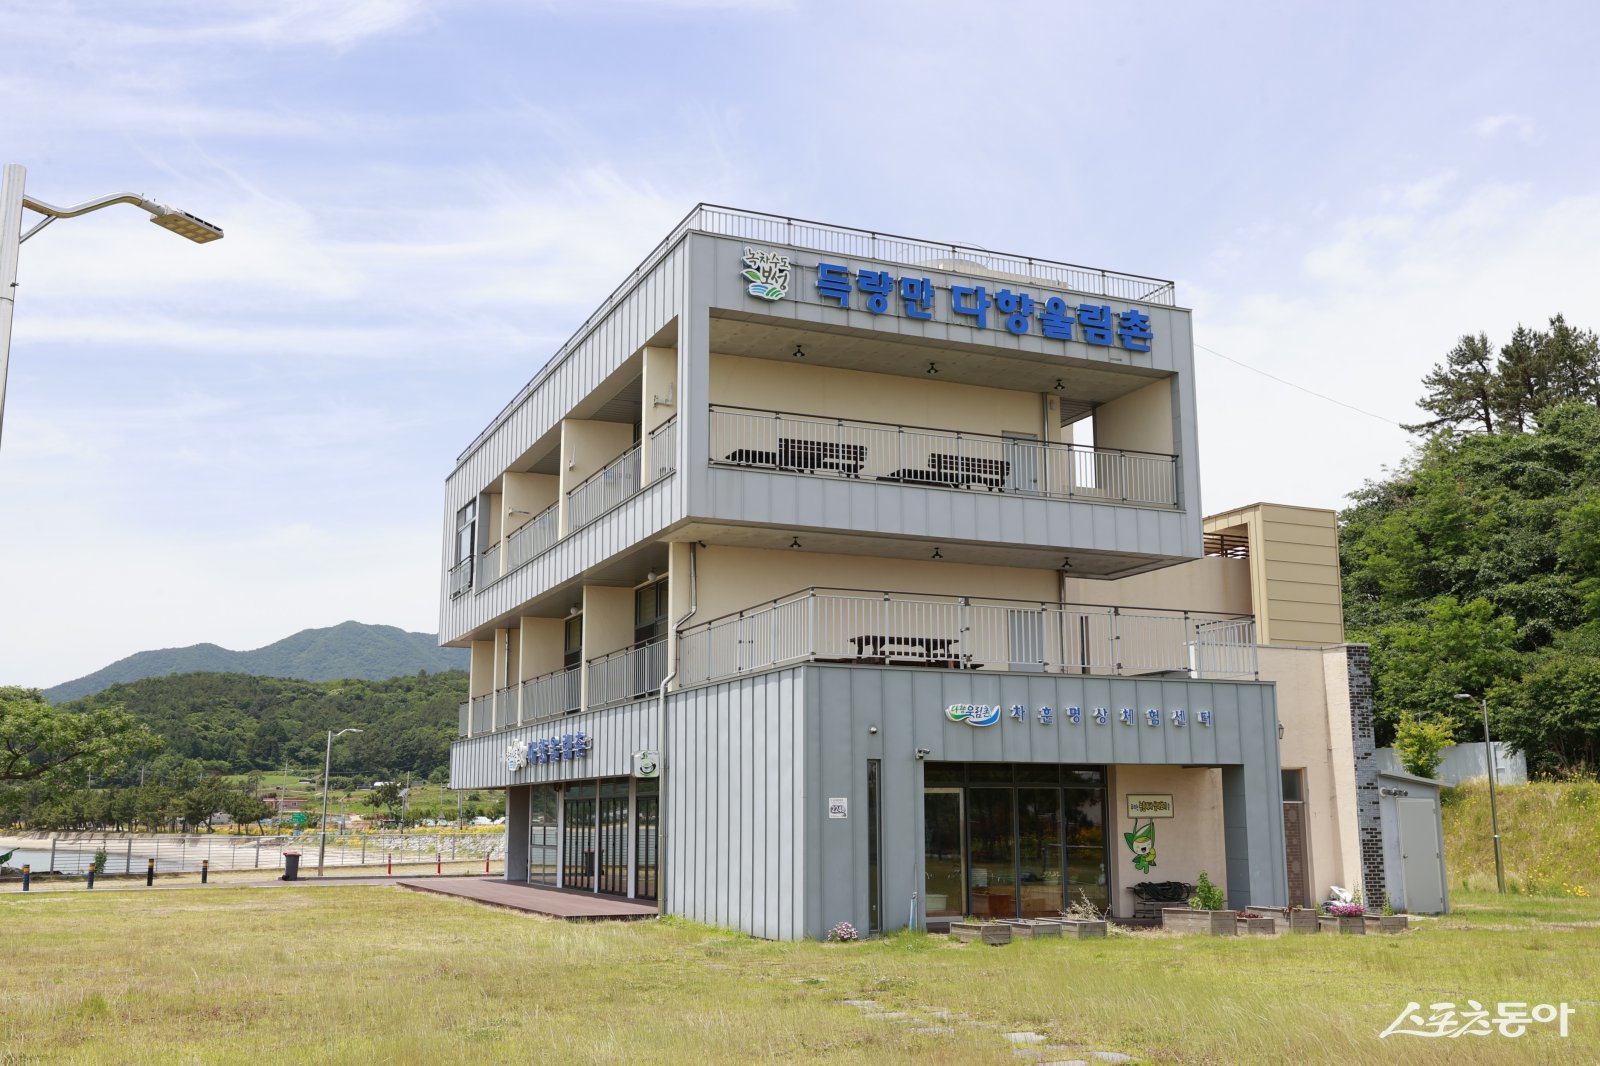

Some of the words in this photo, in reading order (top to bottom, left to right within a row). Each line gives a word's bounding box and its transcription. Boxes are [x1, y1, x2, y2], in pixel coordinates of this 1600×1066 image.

[745, 248, 789, 269] 녹차수도
[761, 265, 788, 291] 보성
[816, 262, 935, 319] 득량만
[951, 285, 1153, 351] 다향울림촌
[1012, 704, 1211, 727] 차훈명상체험센터
